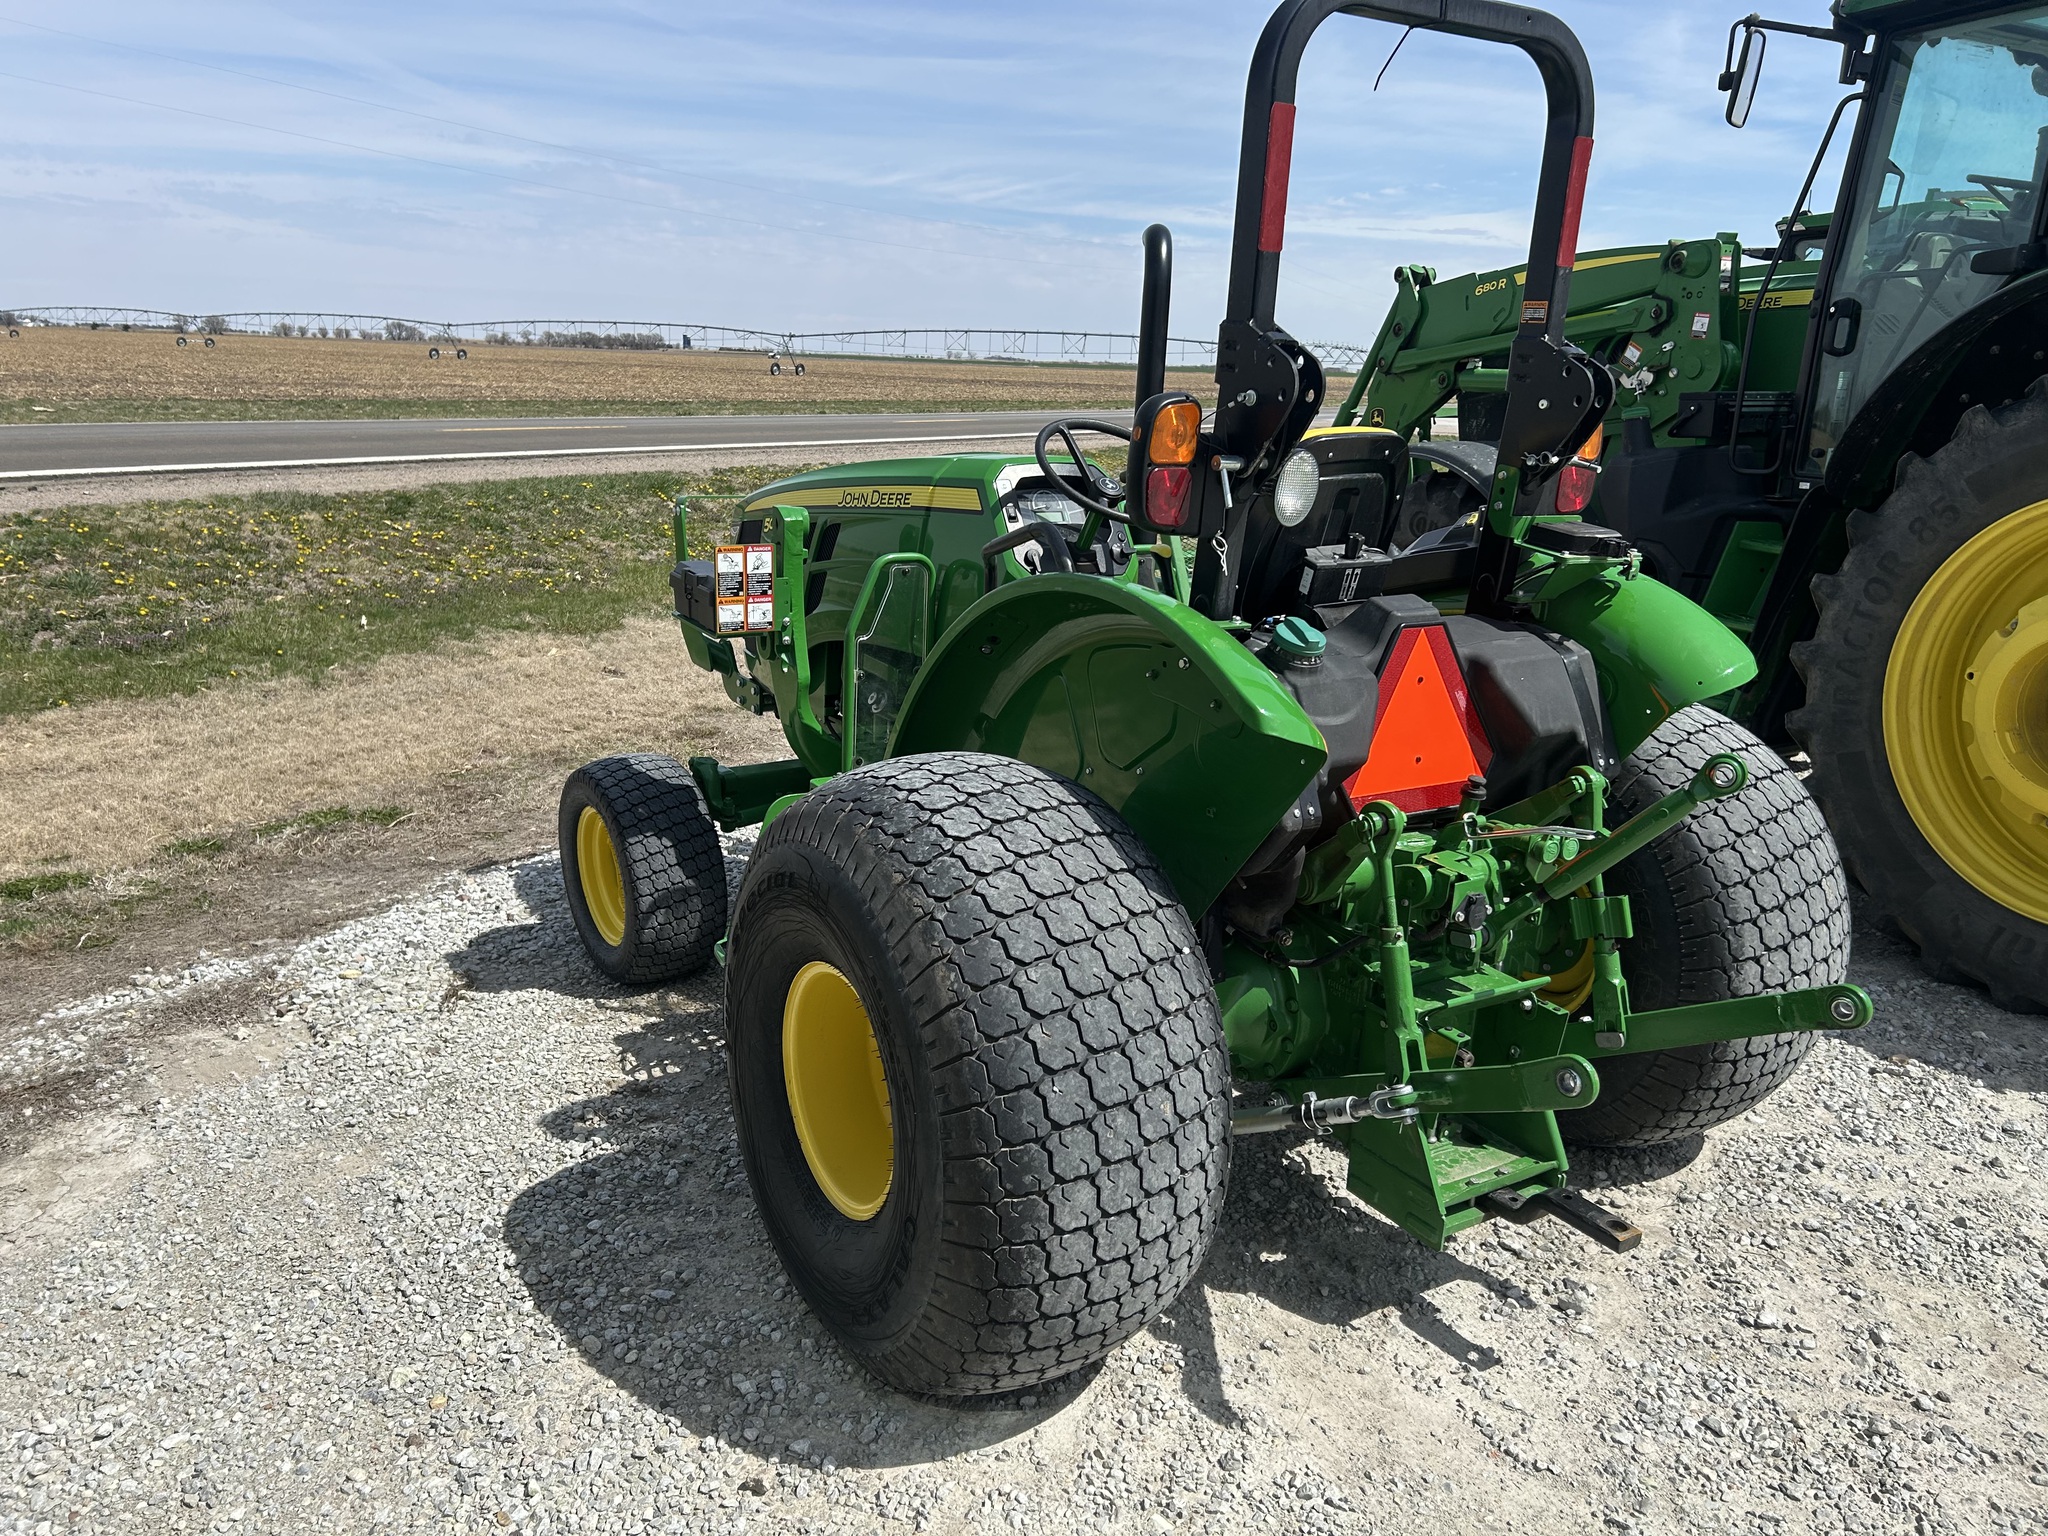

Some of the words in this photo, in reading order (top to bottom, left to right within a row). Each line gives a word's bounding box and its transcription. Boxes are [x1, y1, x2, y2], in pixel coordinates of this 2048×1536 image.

[1475, 281, 1497, 296] 680
[1497, 278, 1507, 290] R
[1739, 296, 1783, 309] DERE
[838, 490, 869, 506] JOHN
[870, 490, 913, 506] DEERE
[763, 517, 773, 532] 5
[1832, 550, 1916, 728] TRACTOR
[1908, 496, 1961, 546] 85
